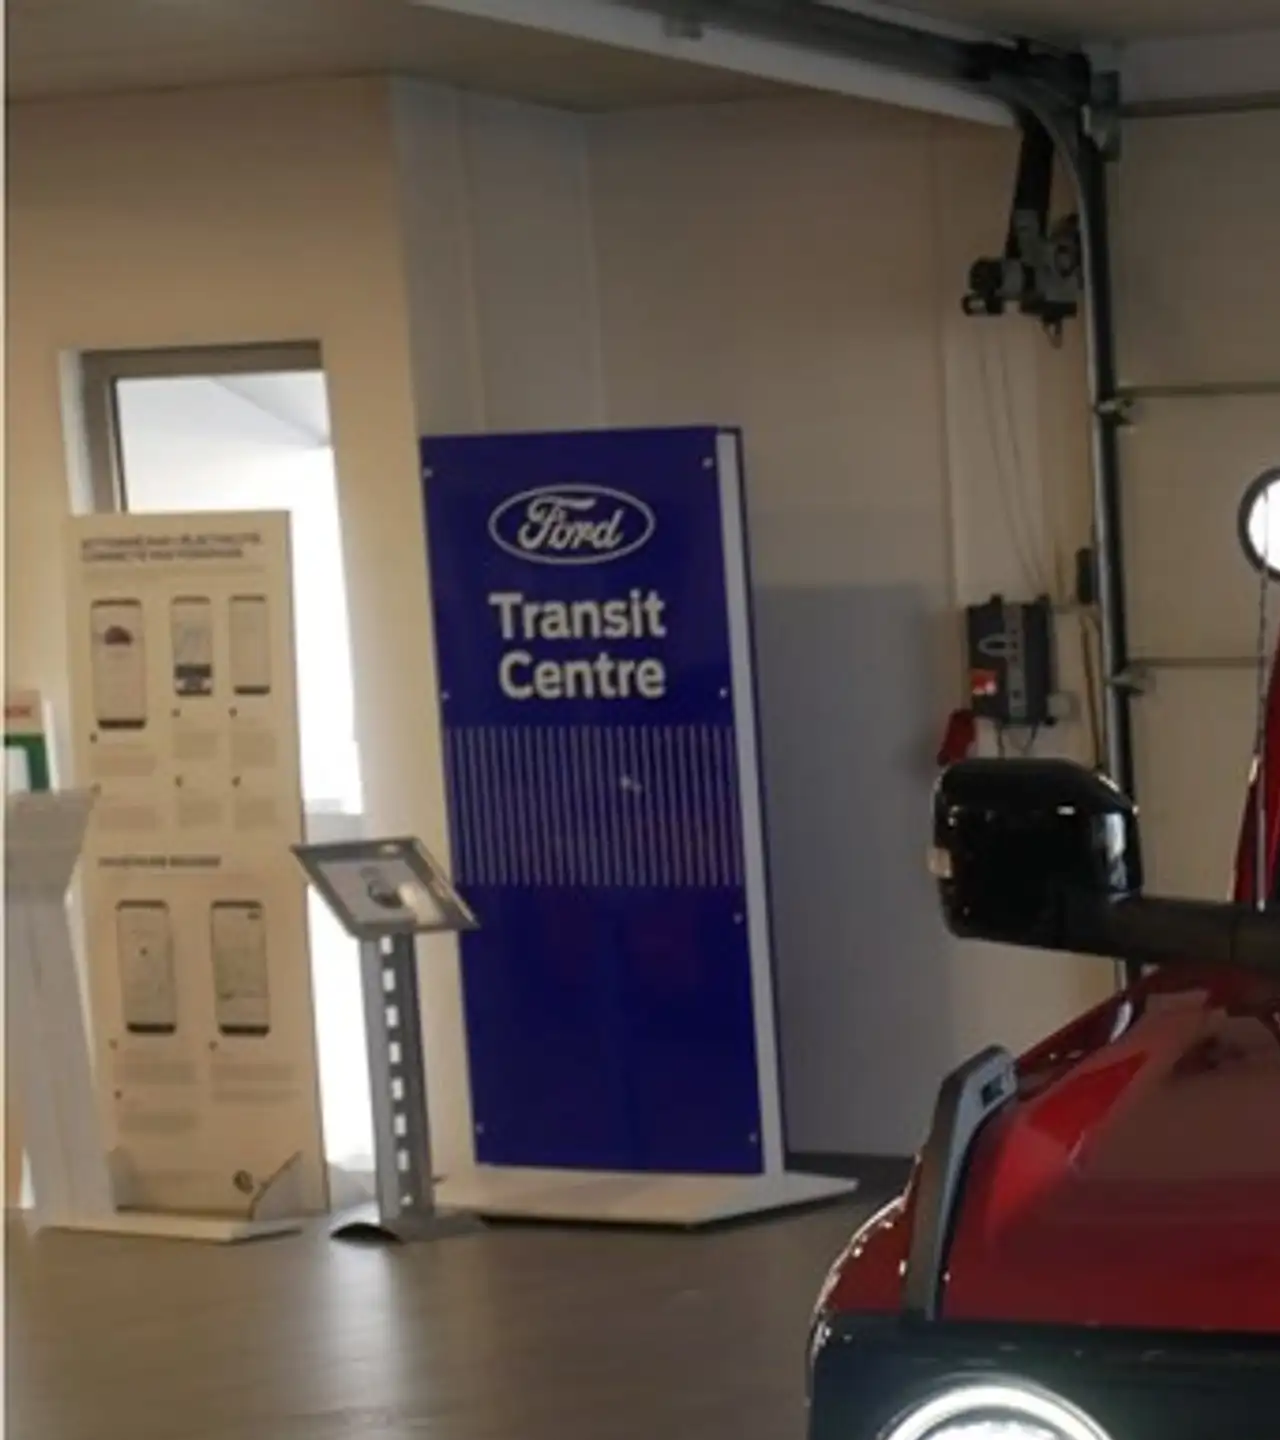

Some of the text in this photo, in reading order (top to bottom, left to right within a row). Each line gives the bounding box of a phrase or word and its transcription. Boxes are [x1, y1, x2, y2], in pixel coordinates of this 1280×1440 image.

[517, 495, 625, 549] Ford
[488, 588, 667, 640] Transit
[499, 650, 666, 699] Centre
